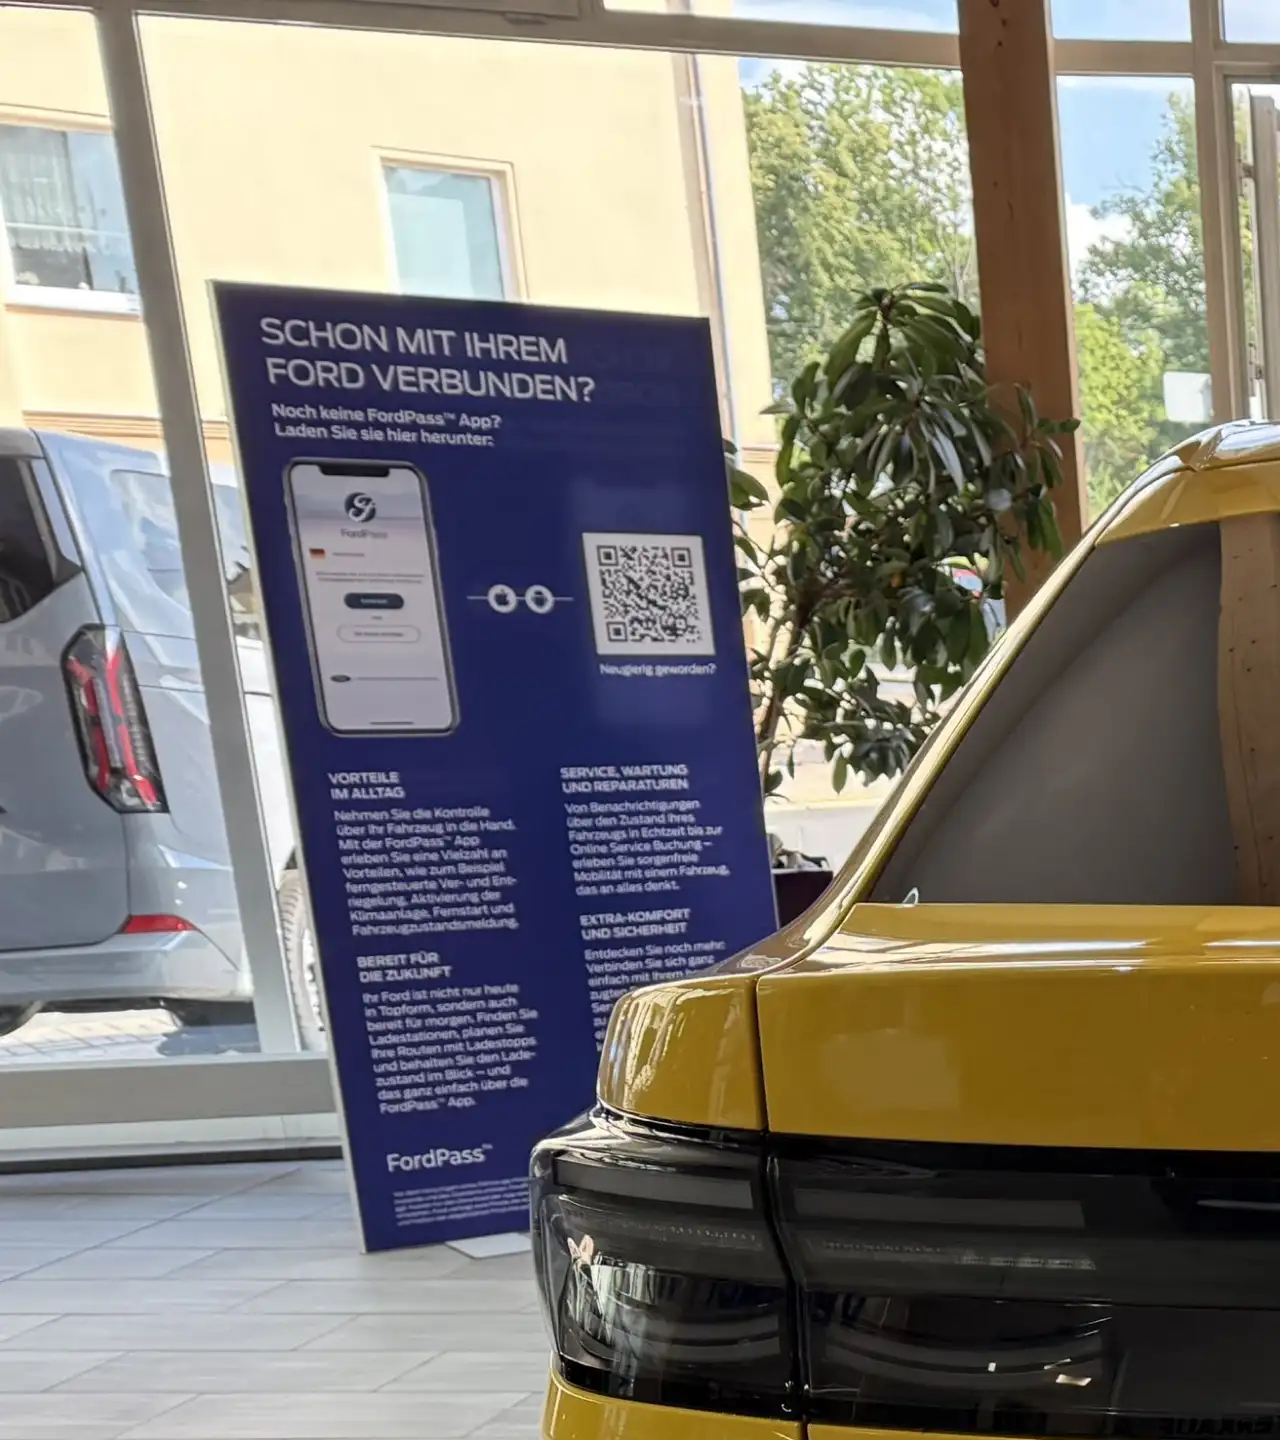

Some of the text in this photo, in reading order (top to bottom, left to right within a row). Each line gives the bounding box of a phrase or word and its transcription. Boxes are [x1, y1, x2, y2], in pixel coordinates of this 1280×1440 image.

[261, 317, 568, 364] SCHON MIT IHREM
[266, 357, 596, 402] FORD VERBUNDEN?
[272, 403, 316, 419] Noch
[319, 405, 364, 421] keine
[459, 412, 501, 430] App?
[275, 423, 495, 448] Laden Sie sie hier herunter:
[655, 663, 717, 677] geworden?
[329, 772, 399, 783] VORTEILE
[561, 764, 688, 778] SERVICE, WARTUNG
[331, 787, 404, 799] IM ALLTAG
[562, 778, 689, 792] UND REPARATUREN
[334, 806, 490, 820] Nehmen Sie die Kontrolle
[564, 799, 700, 812] Von Benachrichtigungen
[337, 824, 364, 834] über
[368, 823, 384, 834] Ihr
[387, 822, 443, 834] Fahrzeug
[460, 820, 477, 831] die
[567, 812, 696, 826] über den Zustand Ihres
[362, 834, 480, 848] der App
[569, 825, 722, 841] Fahrzeugs Echtzeit zur
[570, 839, 702, 853] Online Service Buchung
[341, 848, 488, 864] erleben Sie eine Vielzahl
[572, 852, 698, 867] erleben Sie sorgenfreie
[405, 865, 426, 876] wie
[430, 866, 455, 874] zum
[458, 861, 505, 874] Beispiel
[574, 867, 677, 880] Mobilität mit einem
[345, 875, 489, 893] ferngesteuerte Ver- und
[576, 879, 680, 894] das alles denkt.
[411, 889, 500, 903] Aktivierung der
[433, 903, 488, 916] Fernstart
[491, 902, 514, 913] und
[580, 907, 690, 925] EXTRA-KOMFORT
[582, 921, 688, 939] UND SICHERHEIT
[584, 941, 691, 959] Entdecken Sie noch
[357, 950, 439, 967] BEREIT FÜR
[586, 954, 686, 973] Verbinden Sie sich
[359, 966, 452, 982] DIE ZUKUNFT
[588, 972, 629, 986] einfach
[631, 971, 650, 982] mit
[363, 982, 518, 1002] Ihr Ford nicht nur heute
[380, 995, 517, 1016] Topform, sondern auch
[367, 1007, 538, 1030] bereit für morgen. Finden Sie
[369, 1022, 525, 1044] Ladestationen, planen Sie
[371, 1036, 537, 1058] Ihre Routen mit Ladestopps
[373, 1049, 536, 1072] und behalten Sie den Lade-
[376, 1063, 510, 1086] zustand Blick und
[377, 1088, 401, 1099] das
[435, 1080, 478, 1094] einfach
[481, 1079, 507, 1090] über
[509, 1076, 527, 1087] die
